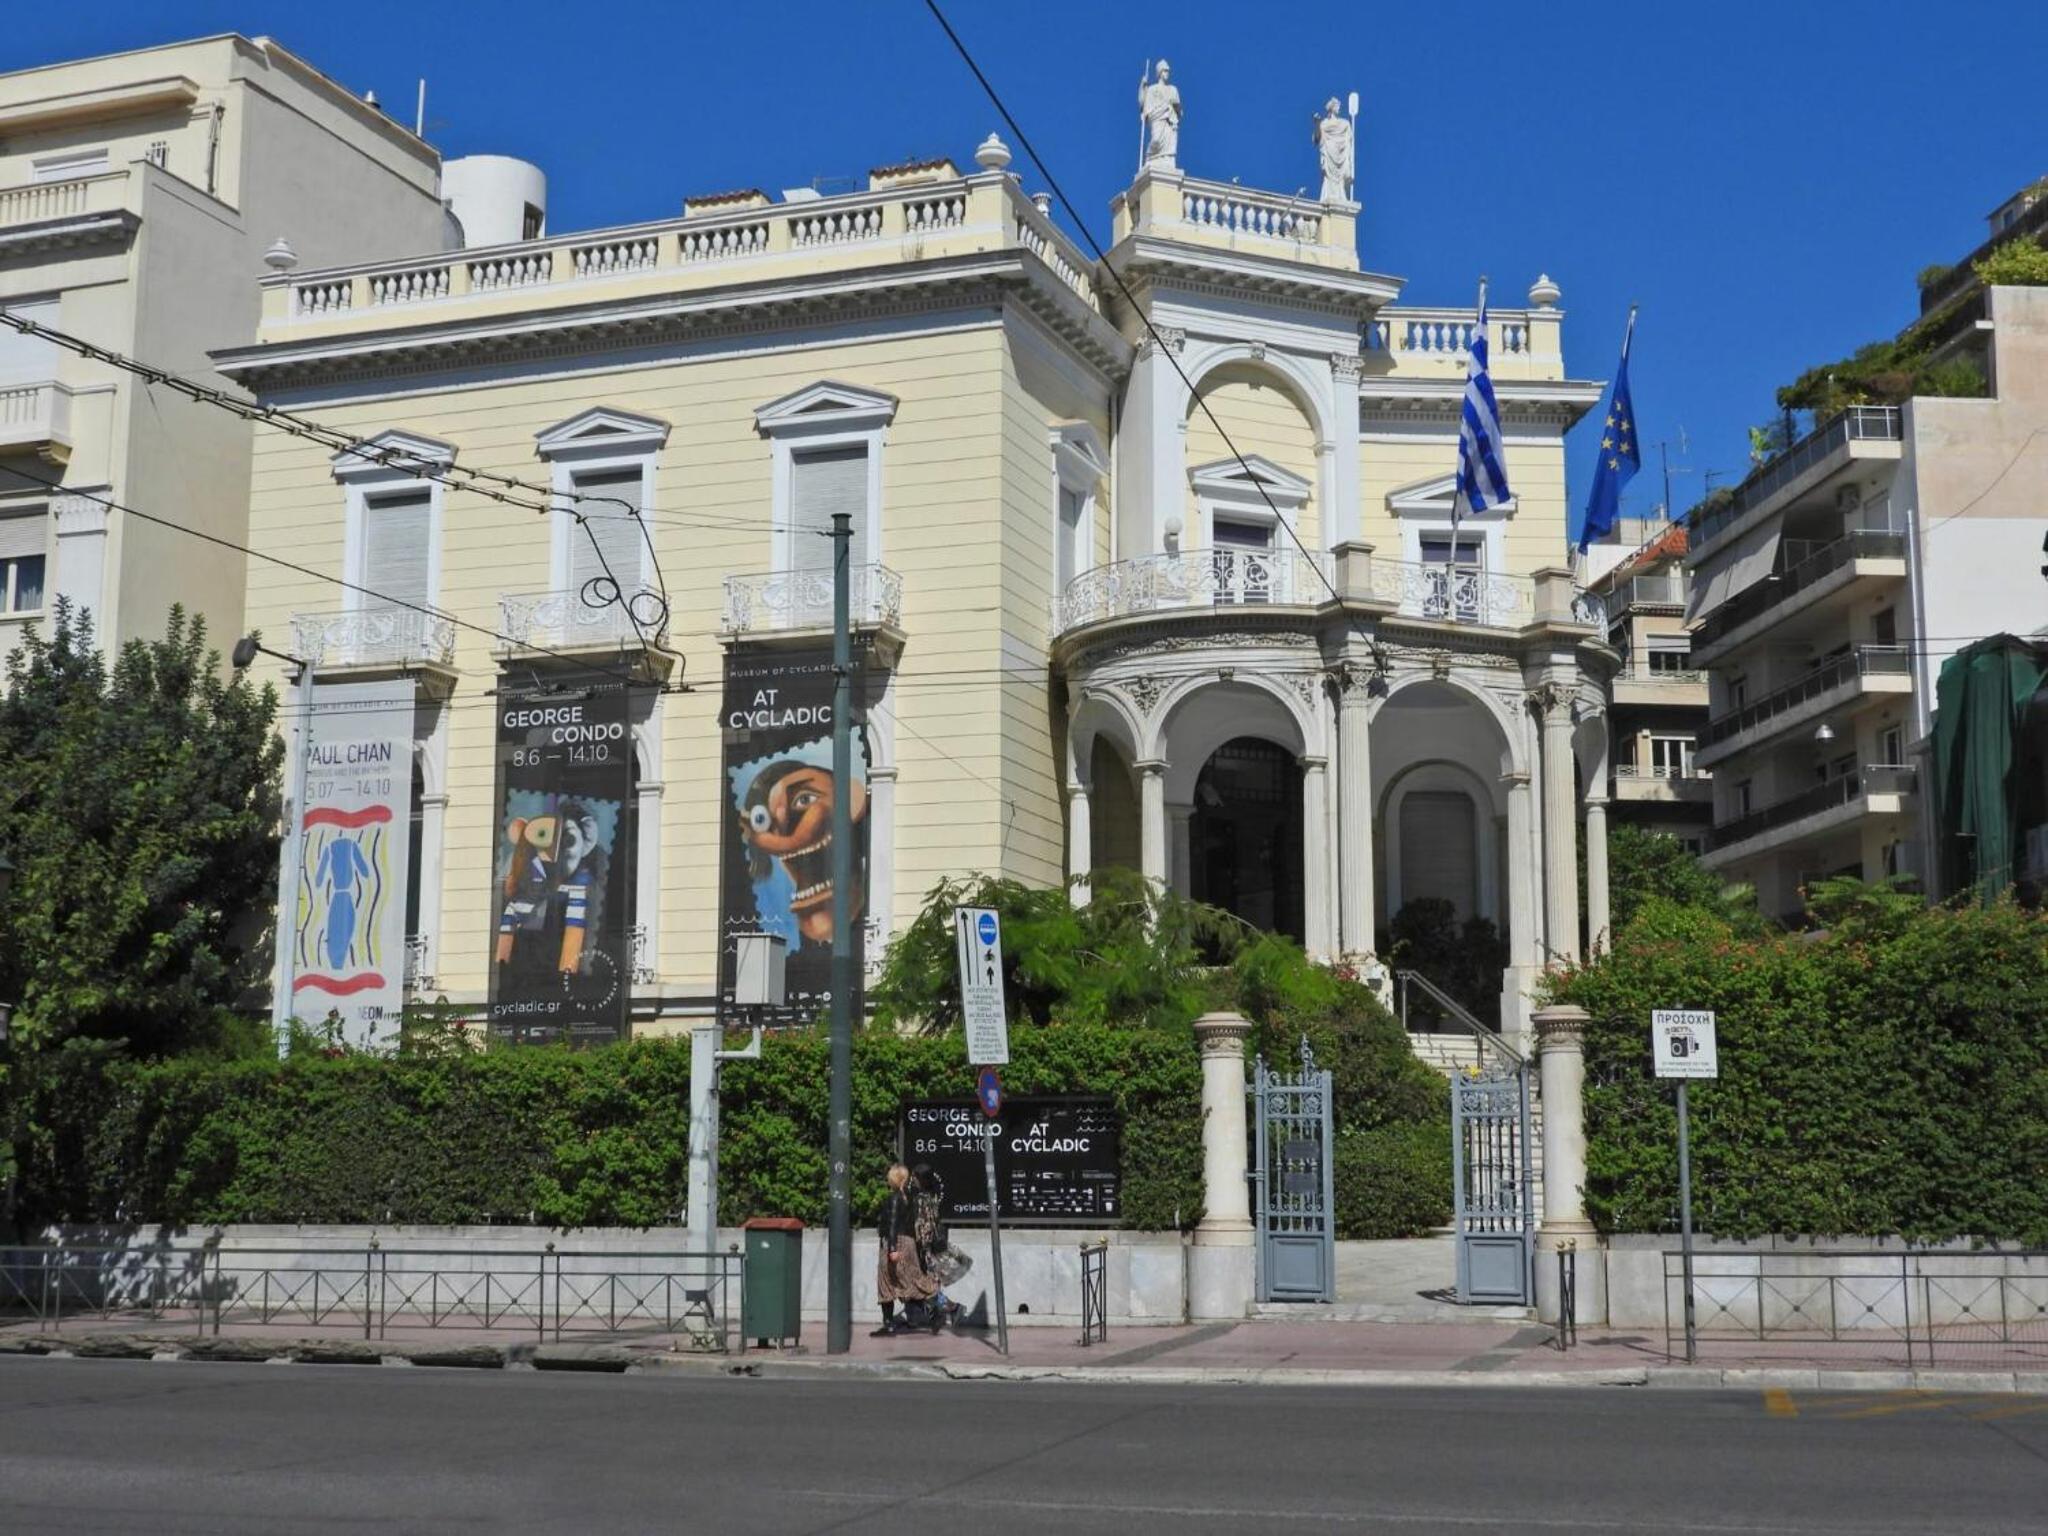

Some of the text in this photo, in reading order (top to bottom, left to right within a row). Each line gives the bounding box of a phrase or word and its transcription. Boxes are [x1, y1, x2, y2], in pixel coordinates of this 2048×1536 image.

[772, 667, 785, 676] OF
[753, 689, 779, 706] AT
[503, 706, 583, 728] GEORGE
[729, 705, 832, 729] CYCLADIC
[551, 722, 624, 743] CONDO
[347, 742, 392, 764] CHAN
[512, 749, 541, 767] 8.6
[568, 743, 609, 763] 14.10
[493, 1001, 561, 1015] cycladic.gr
[1656, 1013, 1711, 1025] ΠΡΟΣΟΧΗ
[907, 1108, 970, 1122] GEORGE
[1029, 1123, 1050, 1137] AT
[915, 1139, 937, 1153] 8.6
[1011, 1138, 1090, 1153] CYCLADIC
